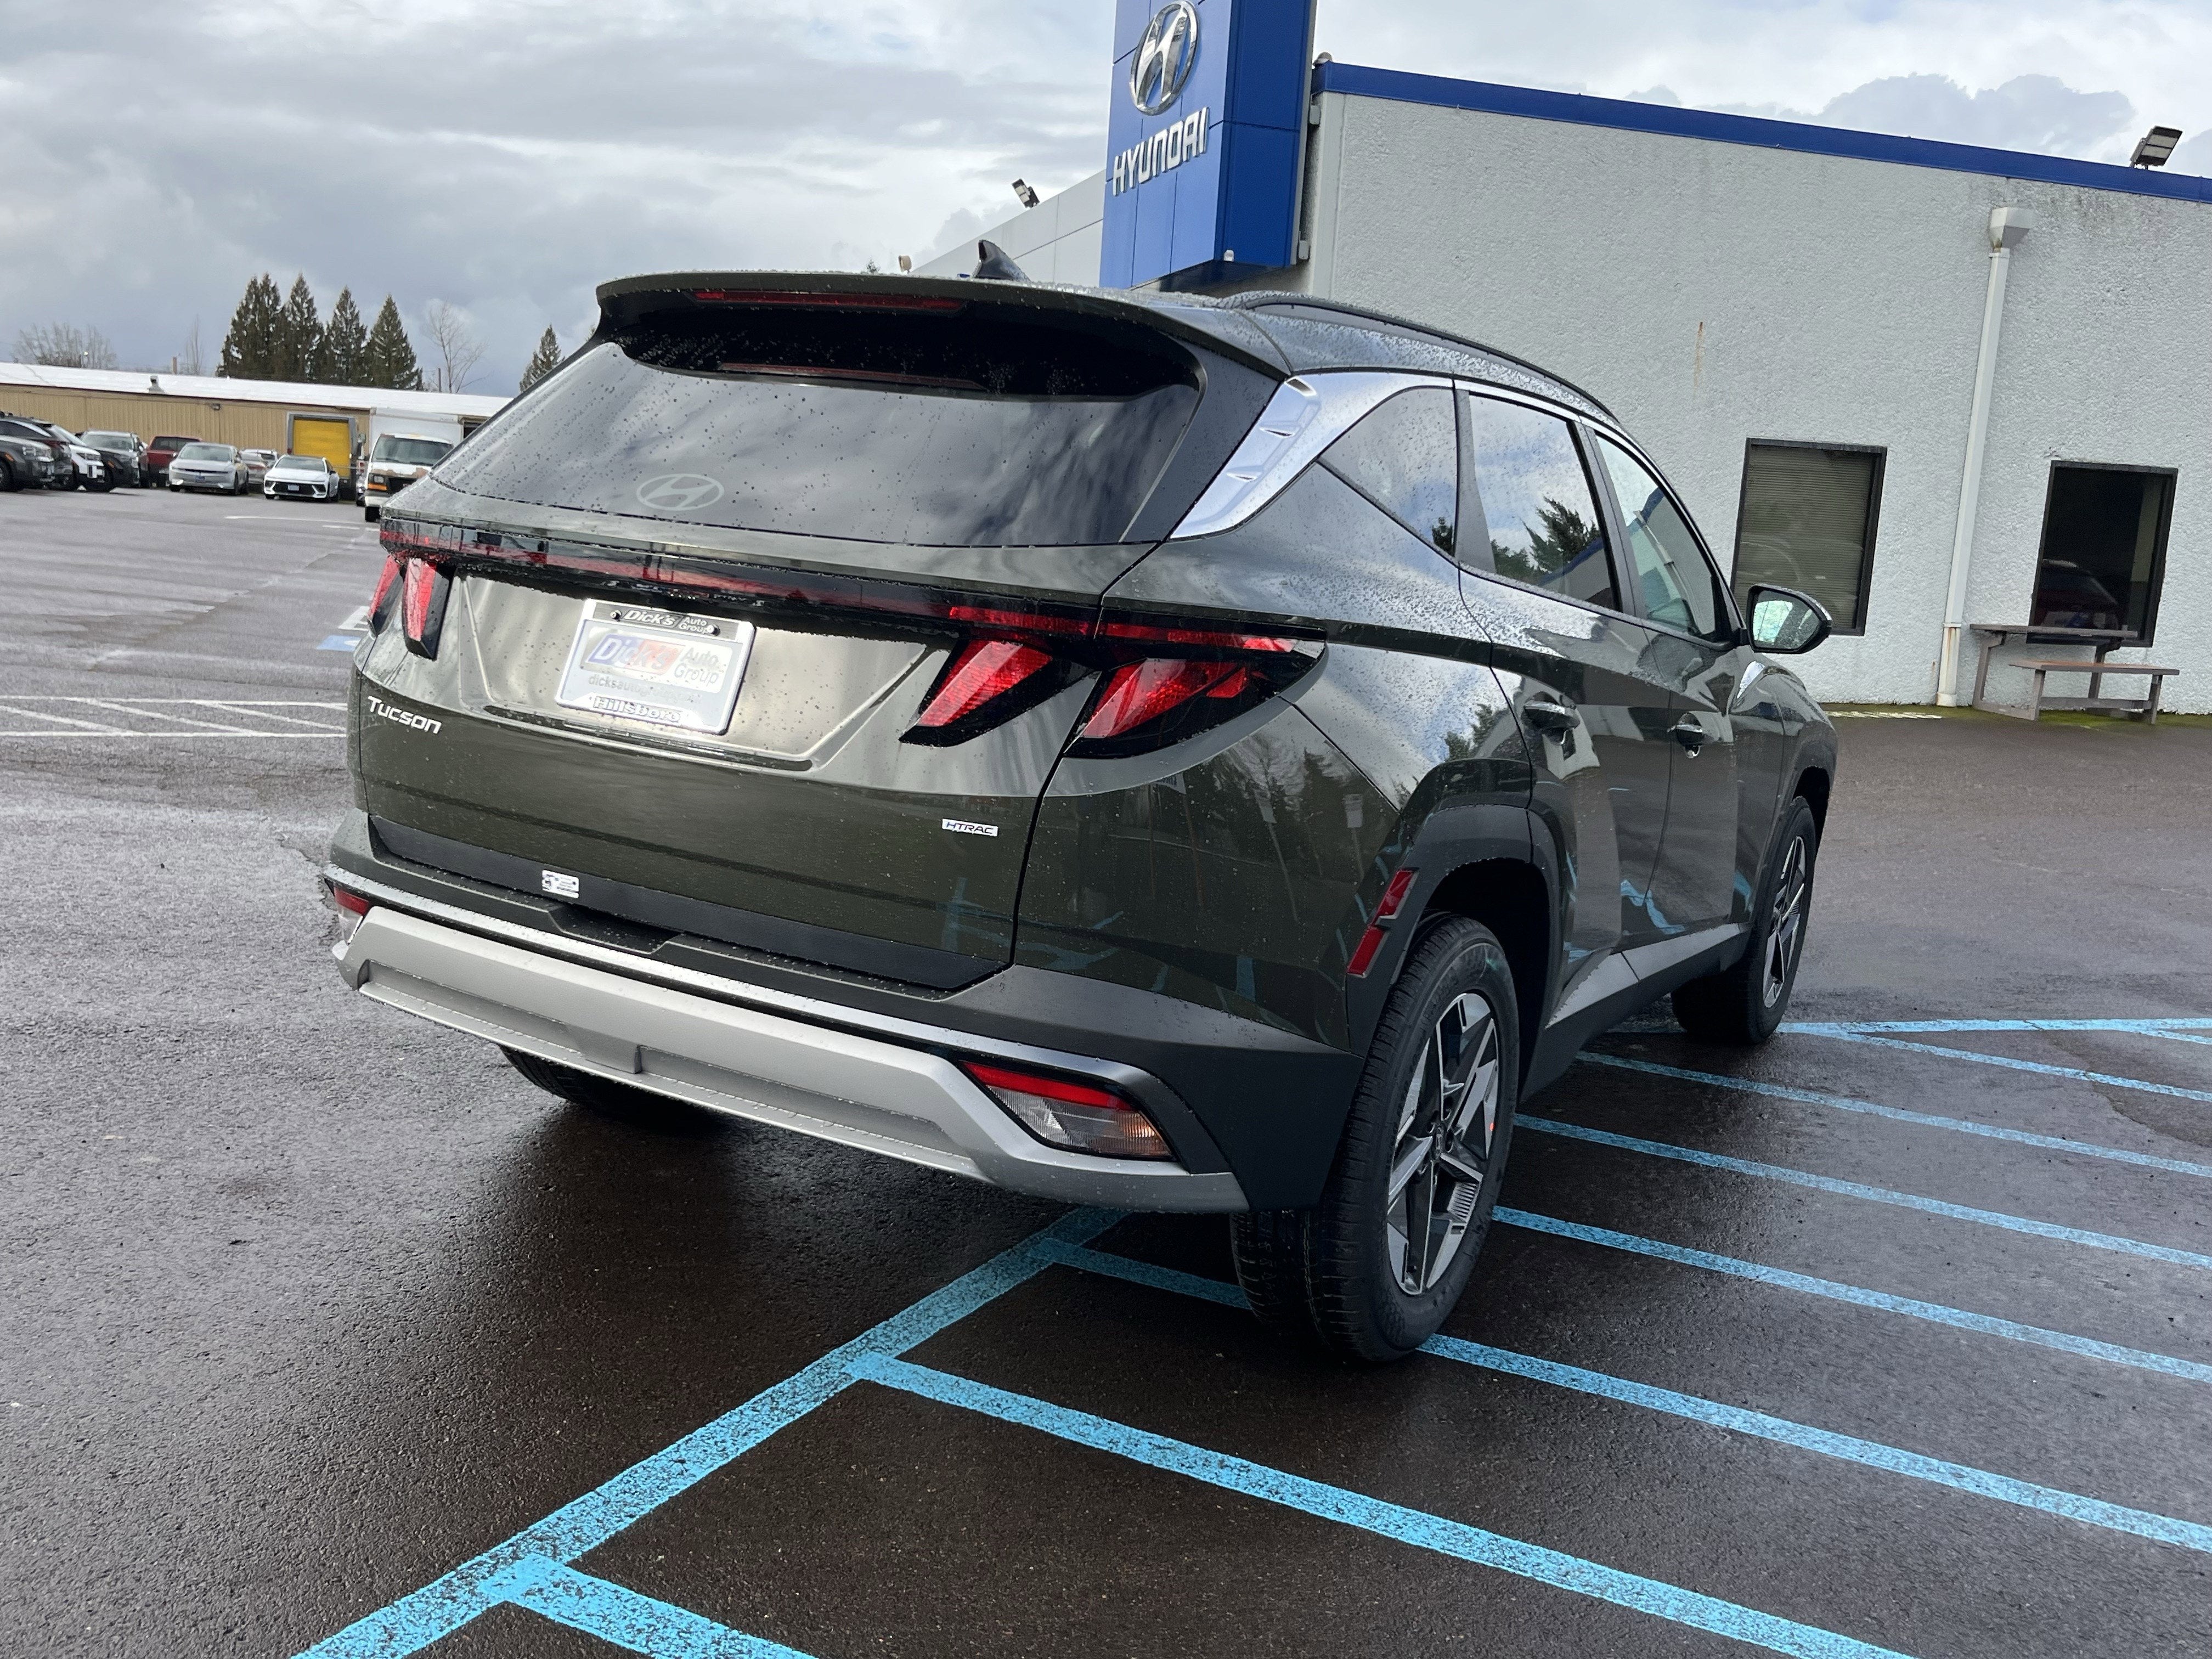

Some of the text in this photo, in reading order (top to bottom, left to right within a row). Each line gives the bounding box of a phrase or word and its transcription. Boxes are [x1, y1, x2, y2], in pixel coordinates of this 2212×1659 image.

[1113, 106, 1210, 196] HYUNDAI
[624, 610, 676, 626] Dick's
[684, 617, 707, 627] Auto
[594, 637, 671, 669] Dick's
[680, 647, 720, 668] Auto
[674, 663, 720, 687] Group
[368, 696, 442, 734] Tucson
[593, 696, 681, 723] Hillsboro
[946, 822, 994, 834] HTRAC
